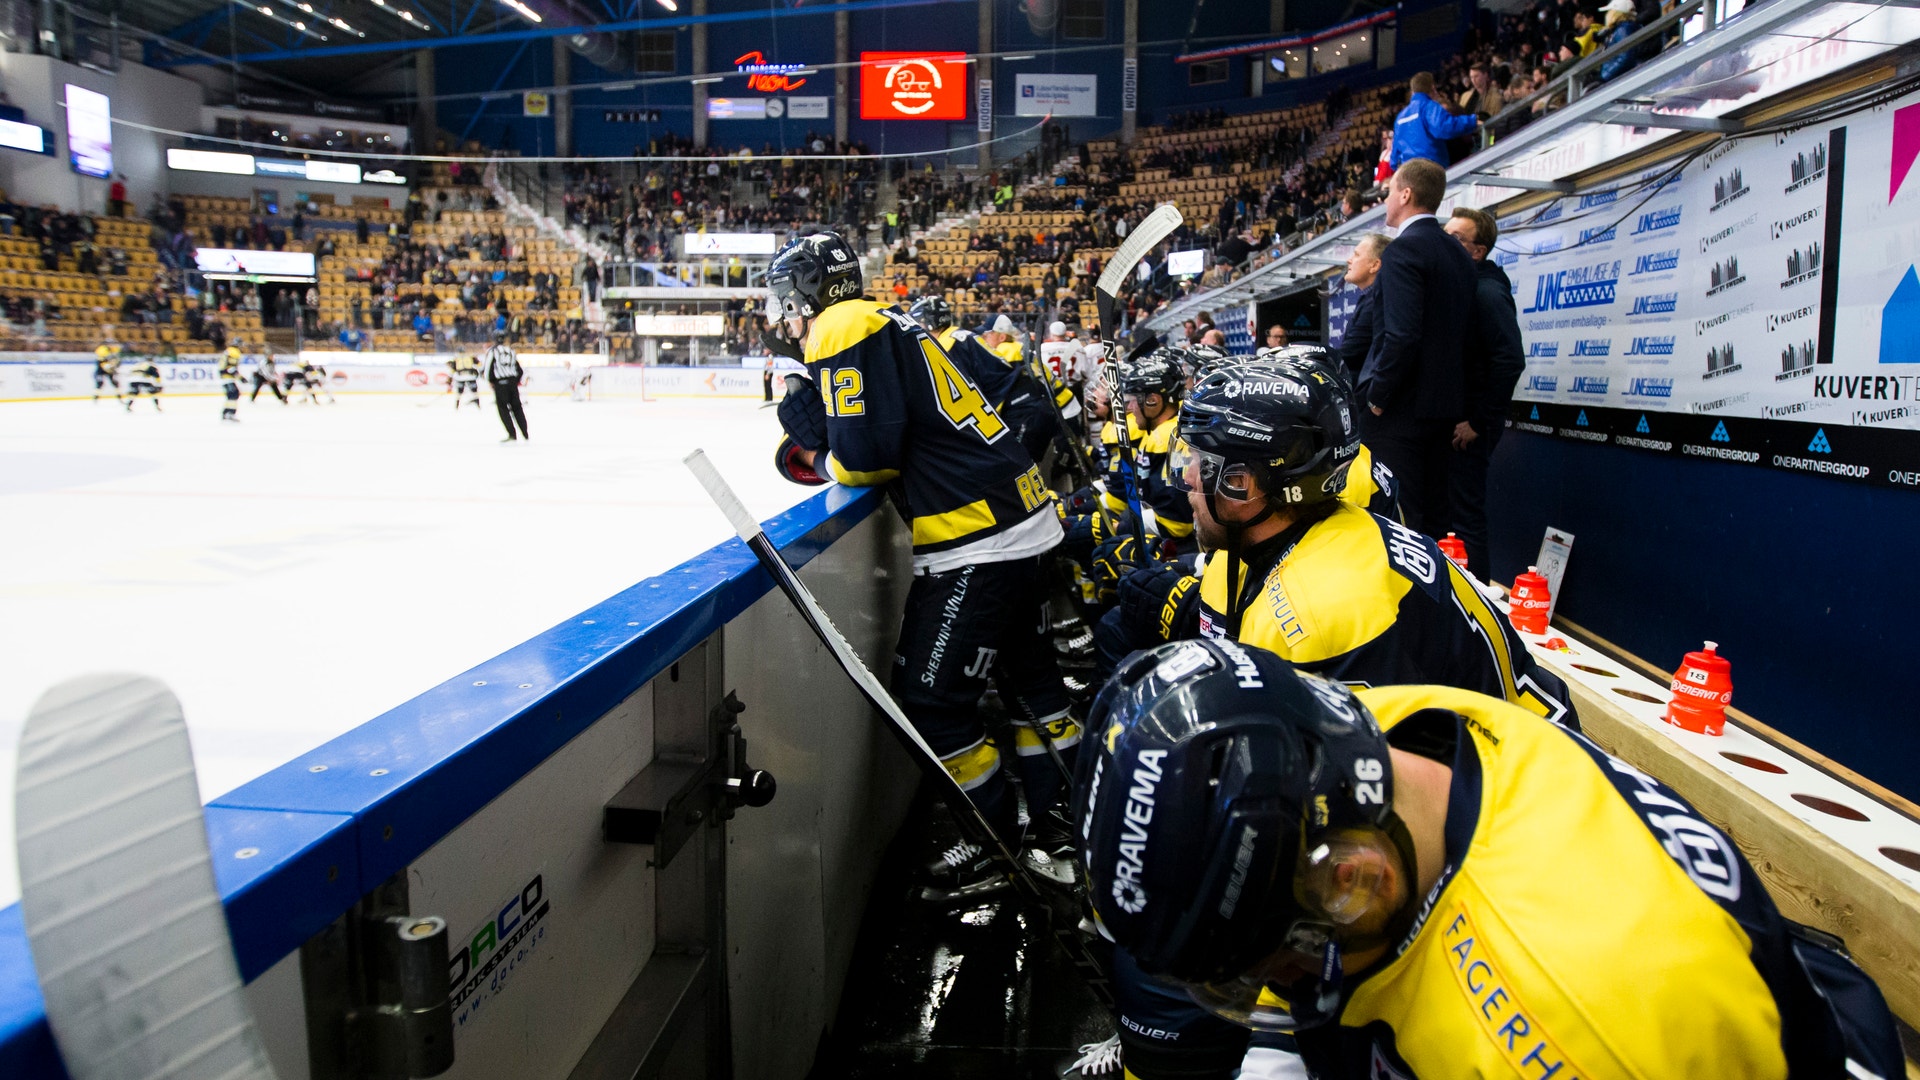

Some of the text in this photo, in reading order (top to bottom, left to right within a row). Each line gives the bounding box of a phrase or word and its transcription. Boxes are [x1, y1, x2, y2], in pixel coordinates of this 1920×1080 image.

[1125, 67, 1136, 109] UNGDOM
[605, 112, 658, 122] PRIMA
[980, 88, 991, 130] UNGDOM
[1729, 186, 1750, 205] SWEDEN
[1725, 275, 1747, 290] SWEDEN
[1781, 276, 1798, 290] PRINT
[1523, 271, 1567, 314] JUNE
[801, 303, 814, 317] 42
[1625, 295, 1652, 316] JUNE
[1528, 315, 1607, 332] Snabbast inom emballage
[1624, 336, 1650, 356] JUNE
[1722, 363, 1743, 376] SWEDEN
[1775, 372, 1792, 382] PRINT
[720, 377, 750, 387] Kitron
[1242, 381, 1309, 398] RAVEMA
[1621, 378, 1647, 396] JUNE
[820, 366, 866, 417] 42
[1102, 339, 1130, 449] NEXUS
[1227, 427, 1273, 443] BAUER
[1559, 427, 1608, 442] ONEPARTNERGROUP
[1615, 435, 1673, 451] ONEPARTNERGROUP
[1682, 444, 1760, 464] ONEPARTNERGROUP
[1773, 455, 1870, 479] ONEPARTNERGROUP
[1282, 486, 1303, 503] 18
[1689, 671, 1706, 681] 18
[1679, 684, 1720, 701] ENERVIT
[1353, 757, 1384, 805] 26
[1116, 749, 1168, 884] RAVEMA
[1446, 913, 1578, 1080] FAGERH
[1121, 1014, 1181, 1041] BAUER
